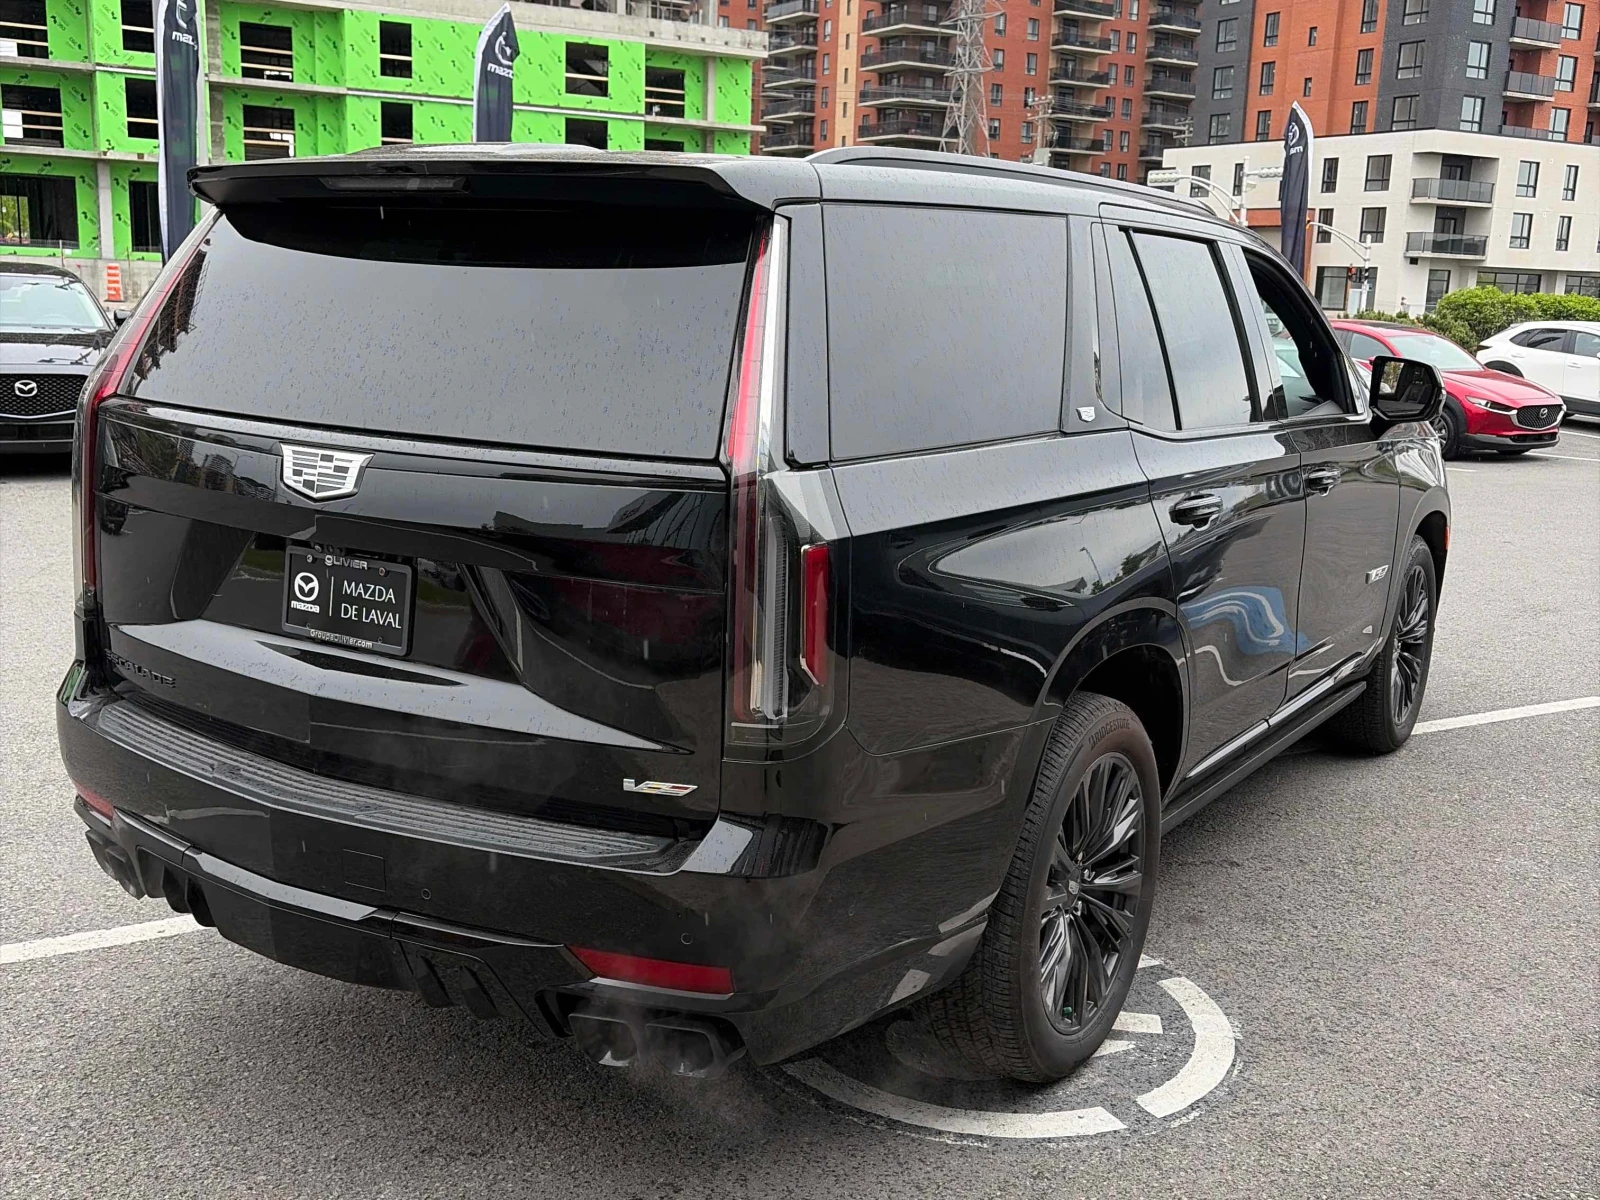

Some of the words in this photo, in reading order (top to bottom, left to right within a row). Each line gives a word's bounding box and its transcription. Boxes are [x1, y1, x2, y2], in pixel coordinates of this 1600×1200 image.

[324, 554, 368, 570] OLIVIER
[342, 580, 396, 604] MAZDA
[291, 600, 320, 614] mazda
[340, 603, 359, 621] DE
[362, 607, 402, 629] LAVAL
